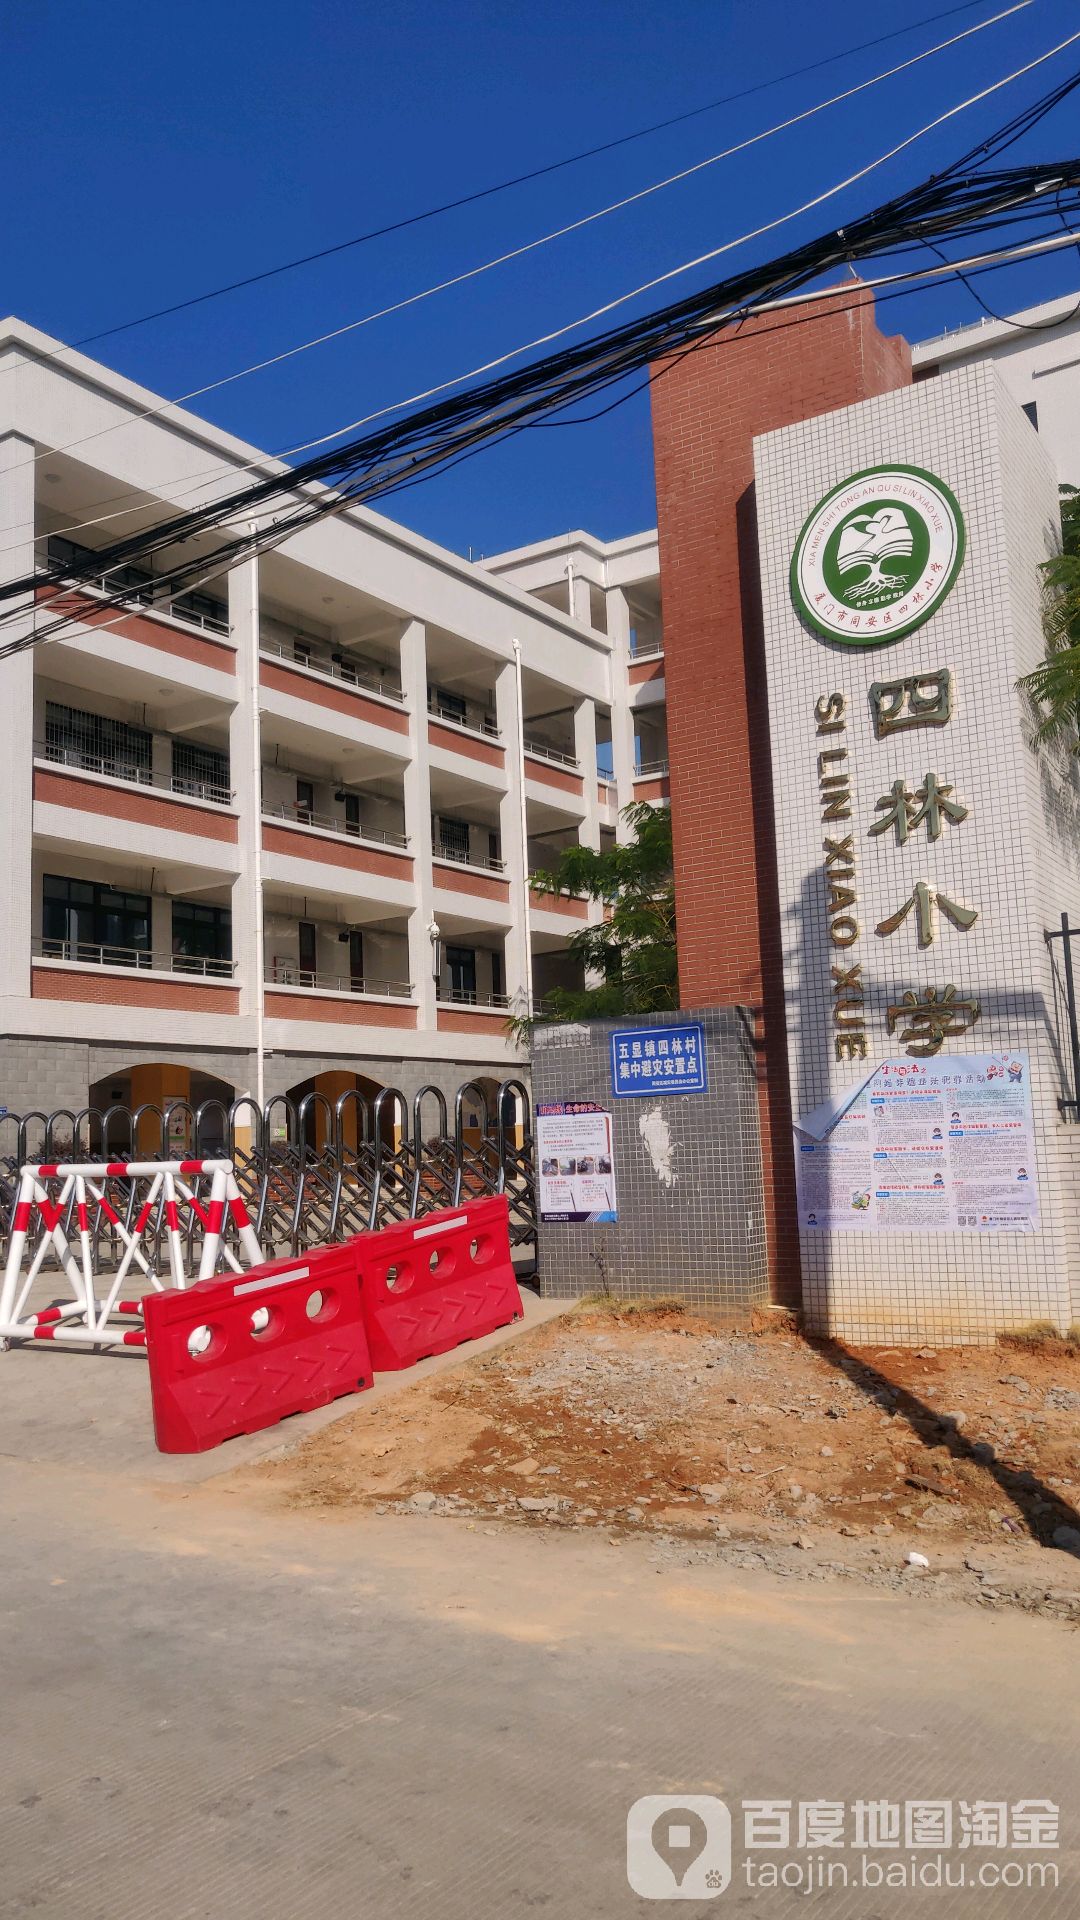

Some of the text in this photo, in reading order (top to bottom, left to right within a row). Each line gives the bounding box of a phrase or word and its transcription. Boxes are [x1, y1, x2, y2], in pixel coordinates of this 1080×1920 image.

[823, 511, 836, 527] SHI
[836, 492, 860, 512] TONG
[862, 486, 875, 496] AN
[814, 562, 943, 628] 厦门市同安区四林小学
[867, 668, 981, 1057] 四林小学
[618, 1036, 696, 1059] 五显镇四林村
[619, 1056, 698, 1079] 集中避灾安置点
